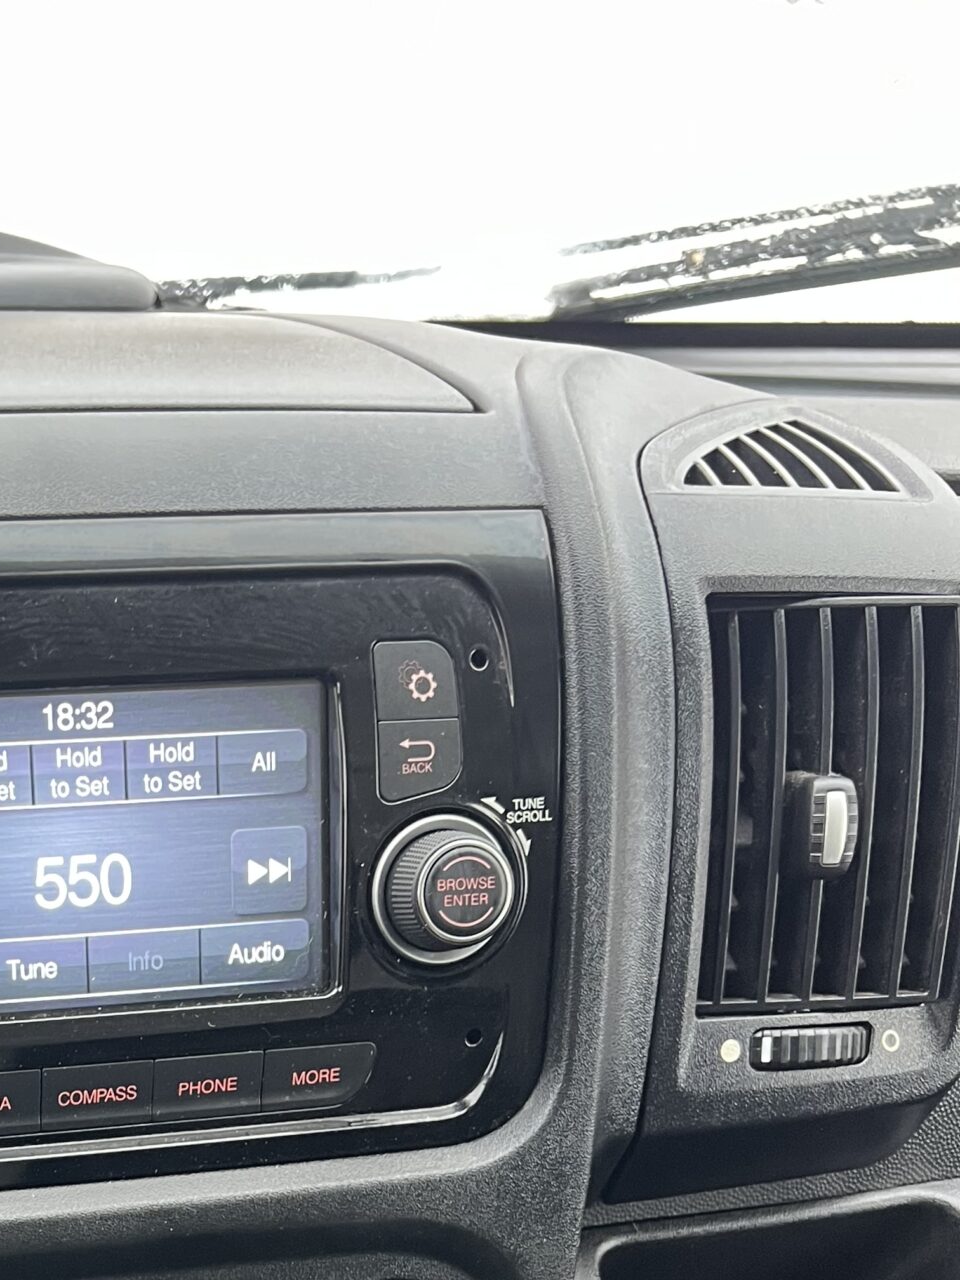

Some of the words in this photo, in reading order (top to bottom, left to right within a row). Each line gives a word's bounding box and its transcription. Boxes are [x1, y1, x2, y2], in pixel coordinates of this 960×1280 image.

[41, 700, 115, 732] 18:32
[56, 746, 102, 769] Hold
[148, 741, 195, 764] Hold
[251, 751, 277, 773] All
[402, 762, 433, 775] BACK
[50, 779, 70, 799] to
[74, 776, 110, 797] Set
[143, 774, 164, 794] to
[168, 771, 202, 792] Set
[512, 797, 545, 810] TUNE
[506, 810, 553, 824] SCROLL
[34, 851, 133, 910] 550
[436, 875, 496, 892] BROWSE
[443, 893, 488, 907] ENTER
[127, 952, 164, 972] Info
[228, 942, 285, 965] Audio
[6, 958, 58, 983] Tune
[178, 1076, 238, 1097] PHONE
[292, 1067, 341, 1087] MORE
[57, 1085, 138, 1107] COMPASS
